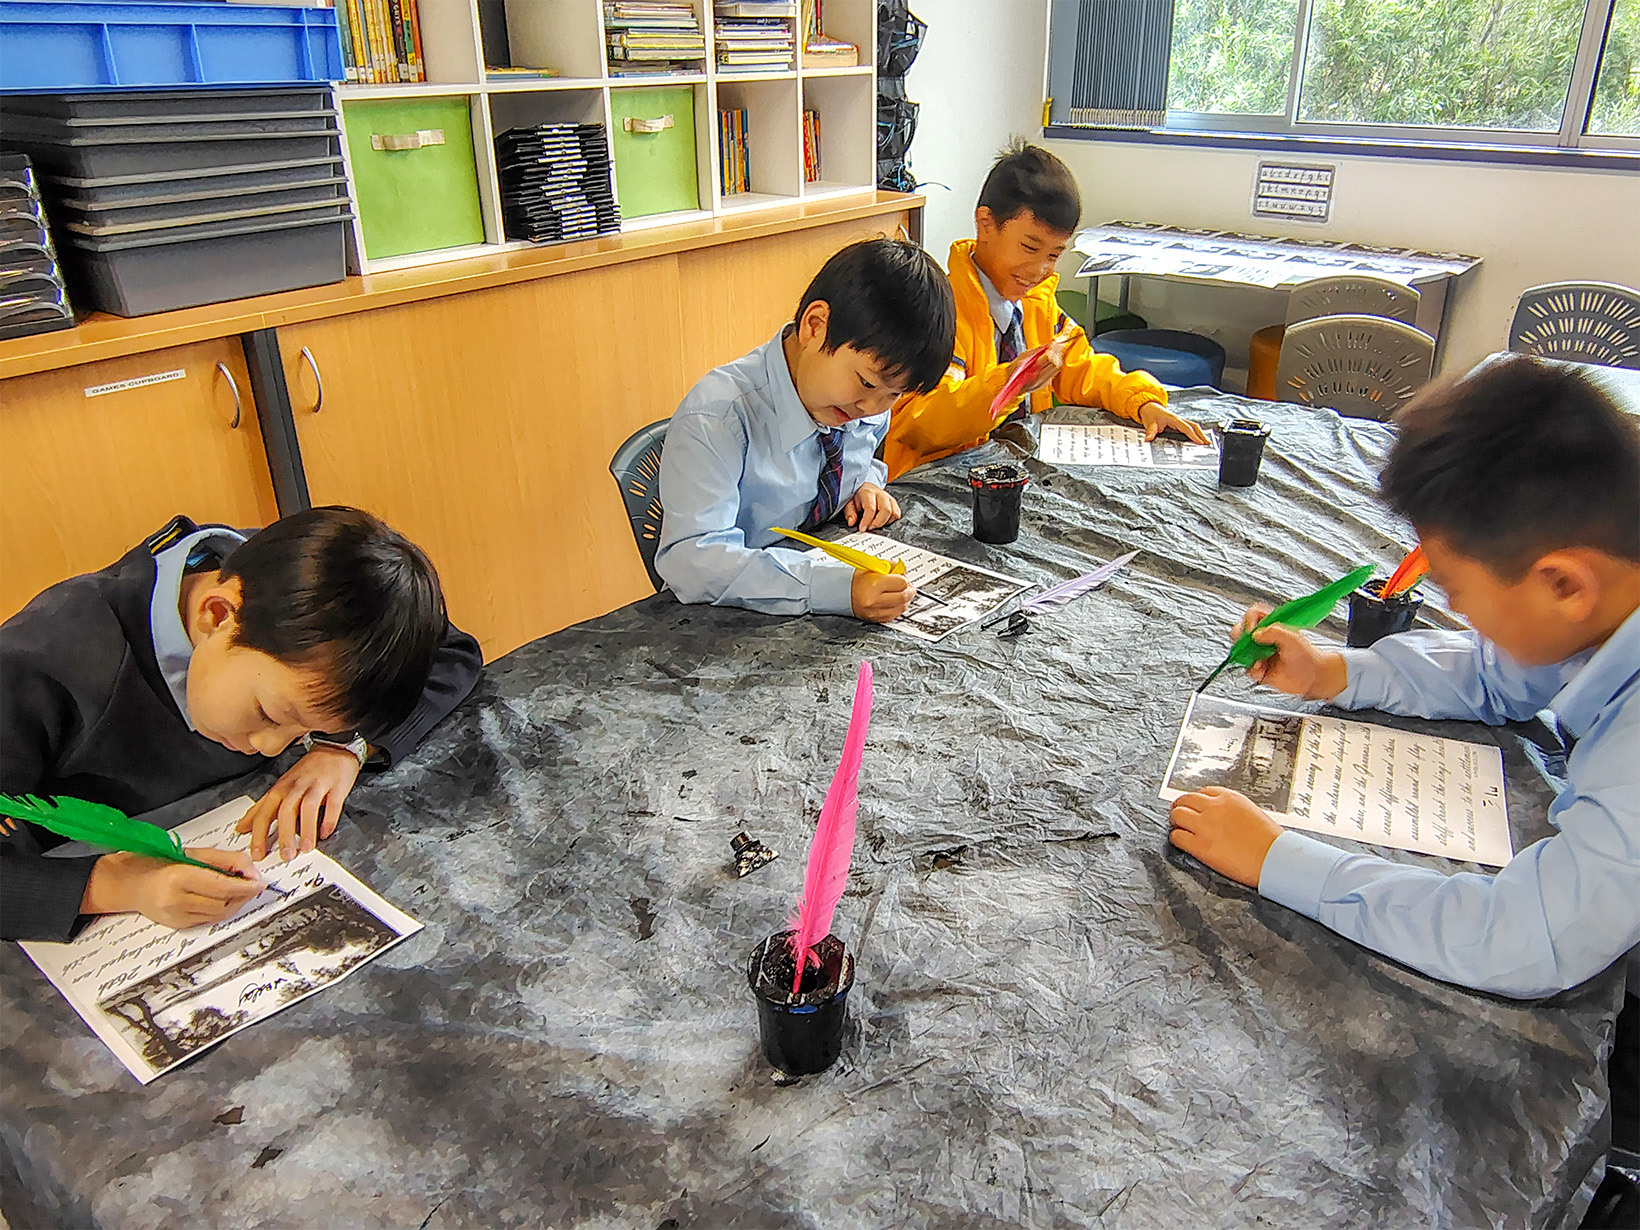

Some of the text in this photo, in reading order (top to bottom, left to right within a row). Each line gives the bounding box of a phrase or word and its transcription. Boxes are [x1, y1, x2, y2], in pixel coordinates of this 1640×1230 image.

[92, 372, 179, 394] GAMES CUPBOARD
[290, 862, 312, 878] the
[95, 931, 176, 977] displayed
[147, 948, 175, 967] the
[176, 936, 197, 957] of
[61, 947, 102, 976] with
[98, 964, 141, 996] 26th
